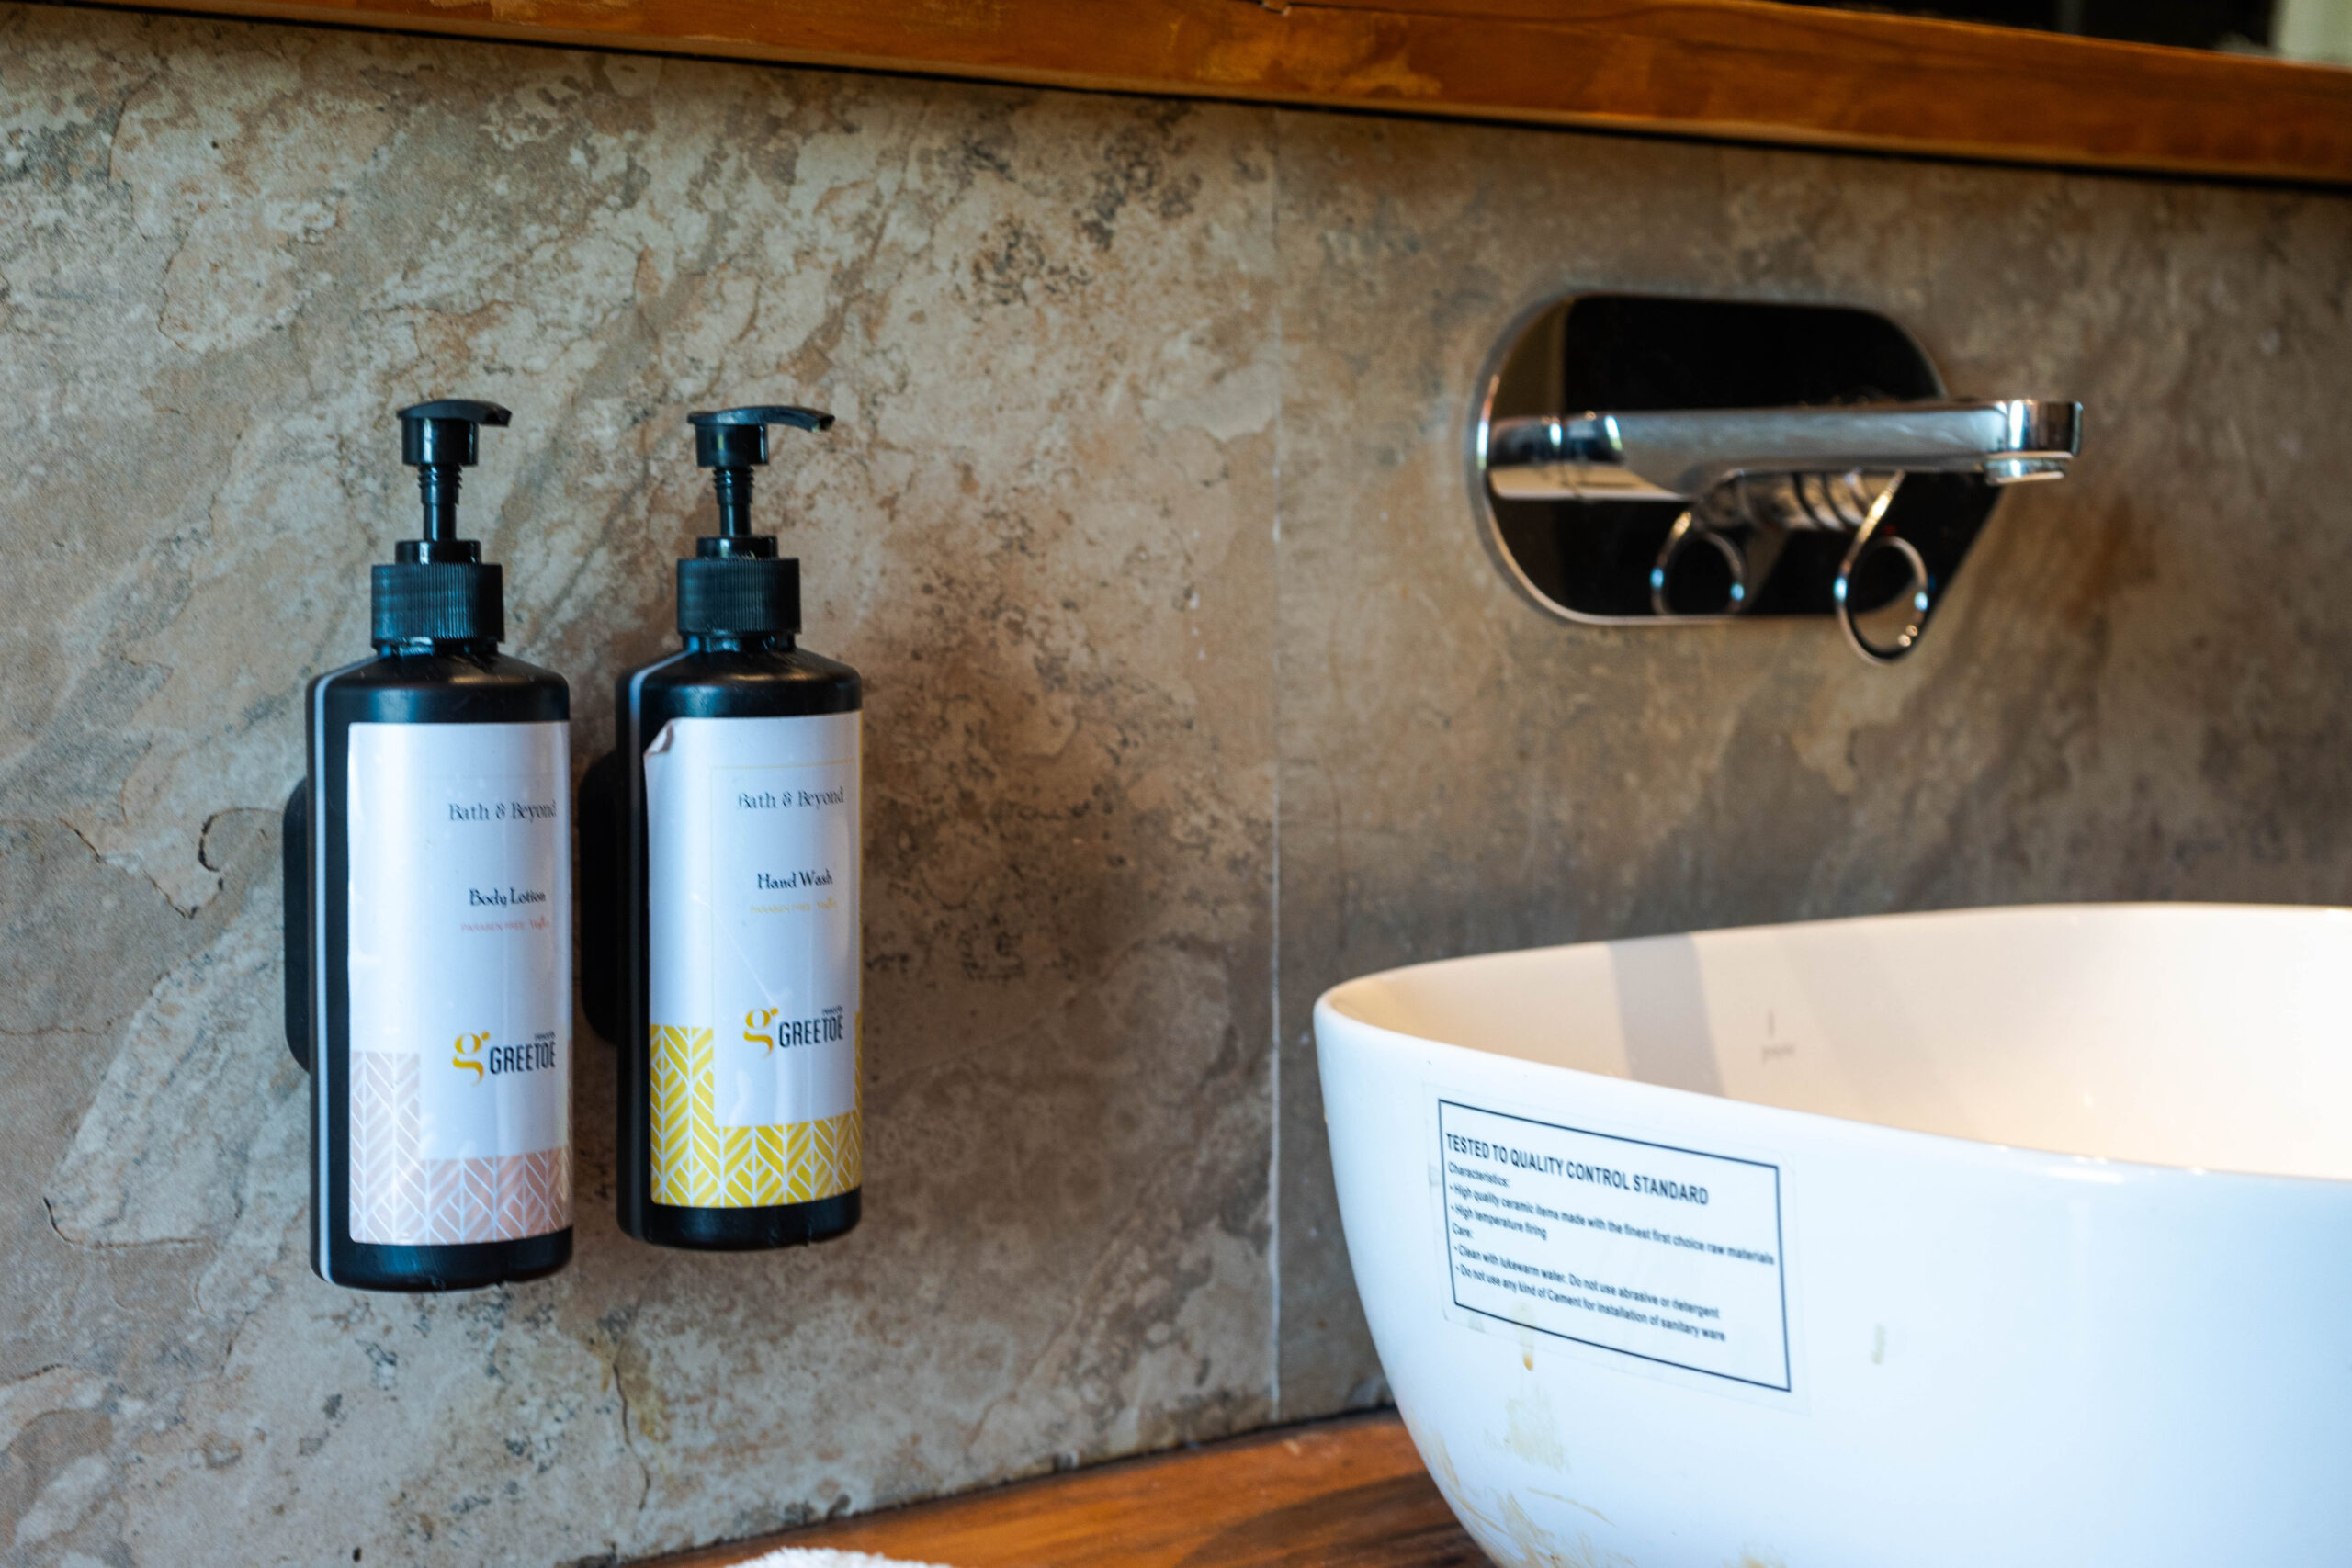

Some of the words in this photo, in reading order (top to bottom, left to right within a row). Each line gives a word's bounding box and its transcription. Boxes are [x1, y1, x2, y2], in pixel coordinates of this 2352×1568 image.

[448, 803, 489, 821] Bath
[495, 803, 505, 819] &
[739, 791, 775, 809] Bath
[782, 791, 792, 808] &
[756, 872, 797, 890] Hand
[797, 868, 833, 887] Wash
[469, 887, 507, 908] Body
[509, 886, 547, 905] Lotion
[779, 1014, 844, 1048] GREETOE
[490, 1041, 556, 1074] GREETOE
[1446, 1133, 1490, 1159] TESTED
[1492, 1144, 1508, 1164] TO
[1510, 1148, 1563, 1176] QUALITY
[1566, 1160, 1630, 1190] CONTROL
[1634, 1173, 1709, 1206] STANDARD
[1501, 1198, 1534, 1214] ceramic
[1561, 1212, 1586, 1226] made
[1588, 1217, 1606, 1231] with
[1608, 1220, 1623, 1235] the
[1624, 1223, 1651, 1240] finest
[1652, 1228, 1671, 1245] first
[1672, 1235, 1704, 1251] choice
[1707, 1243, 1724, 1255] raw
[1727, 1247, 1774, 1265] materials
[1458, 1244, 1482, 1260] Clean
[1483, 1253, 1499, 1266] with
[1499, 1257, 1540, 1277] lukewarm
[1568, 1273, 1582, 1288] Do
[1583, 1280, 1599, 1292] not
[1600, 1284, 1617, 1296] use
[1618, 1287, 1658, 1305] abrasive
[1660, 1297, 1671, 1308] or
[1672, 1297, 1719, 1319] detergent
[1459, 1264, 1472, 1278] Do
[1473, 1269, 1486, 1282] not
[1487, 1274, 1501, 1287] use
[1503, 1278, 1517, 1293] any
[1518, 1280, 1537, 1297] kind
[1537, 1287, 1547, 1299] of
[1547, 1288, 1582, 1308] Cement
[1583, 1297, 1596, 1311] for
[1597, 1301, 1647, 1324] installation
[1649, 1314, 1659, 1326] of
[1660, 1318, 1699, 1339] sanitary
[1701, 1328, 1726, 1342] ware
